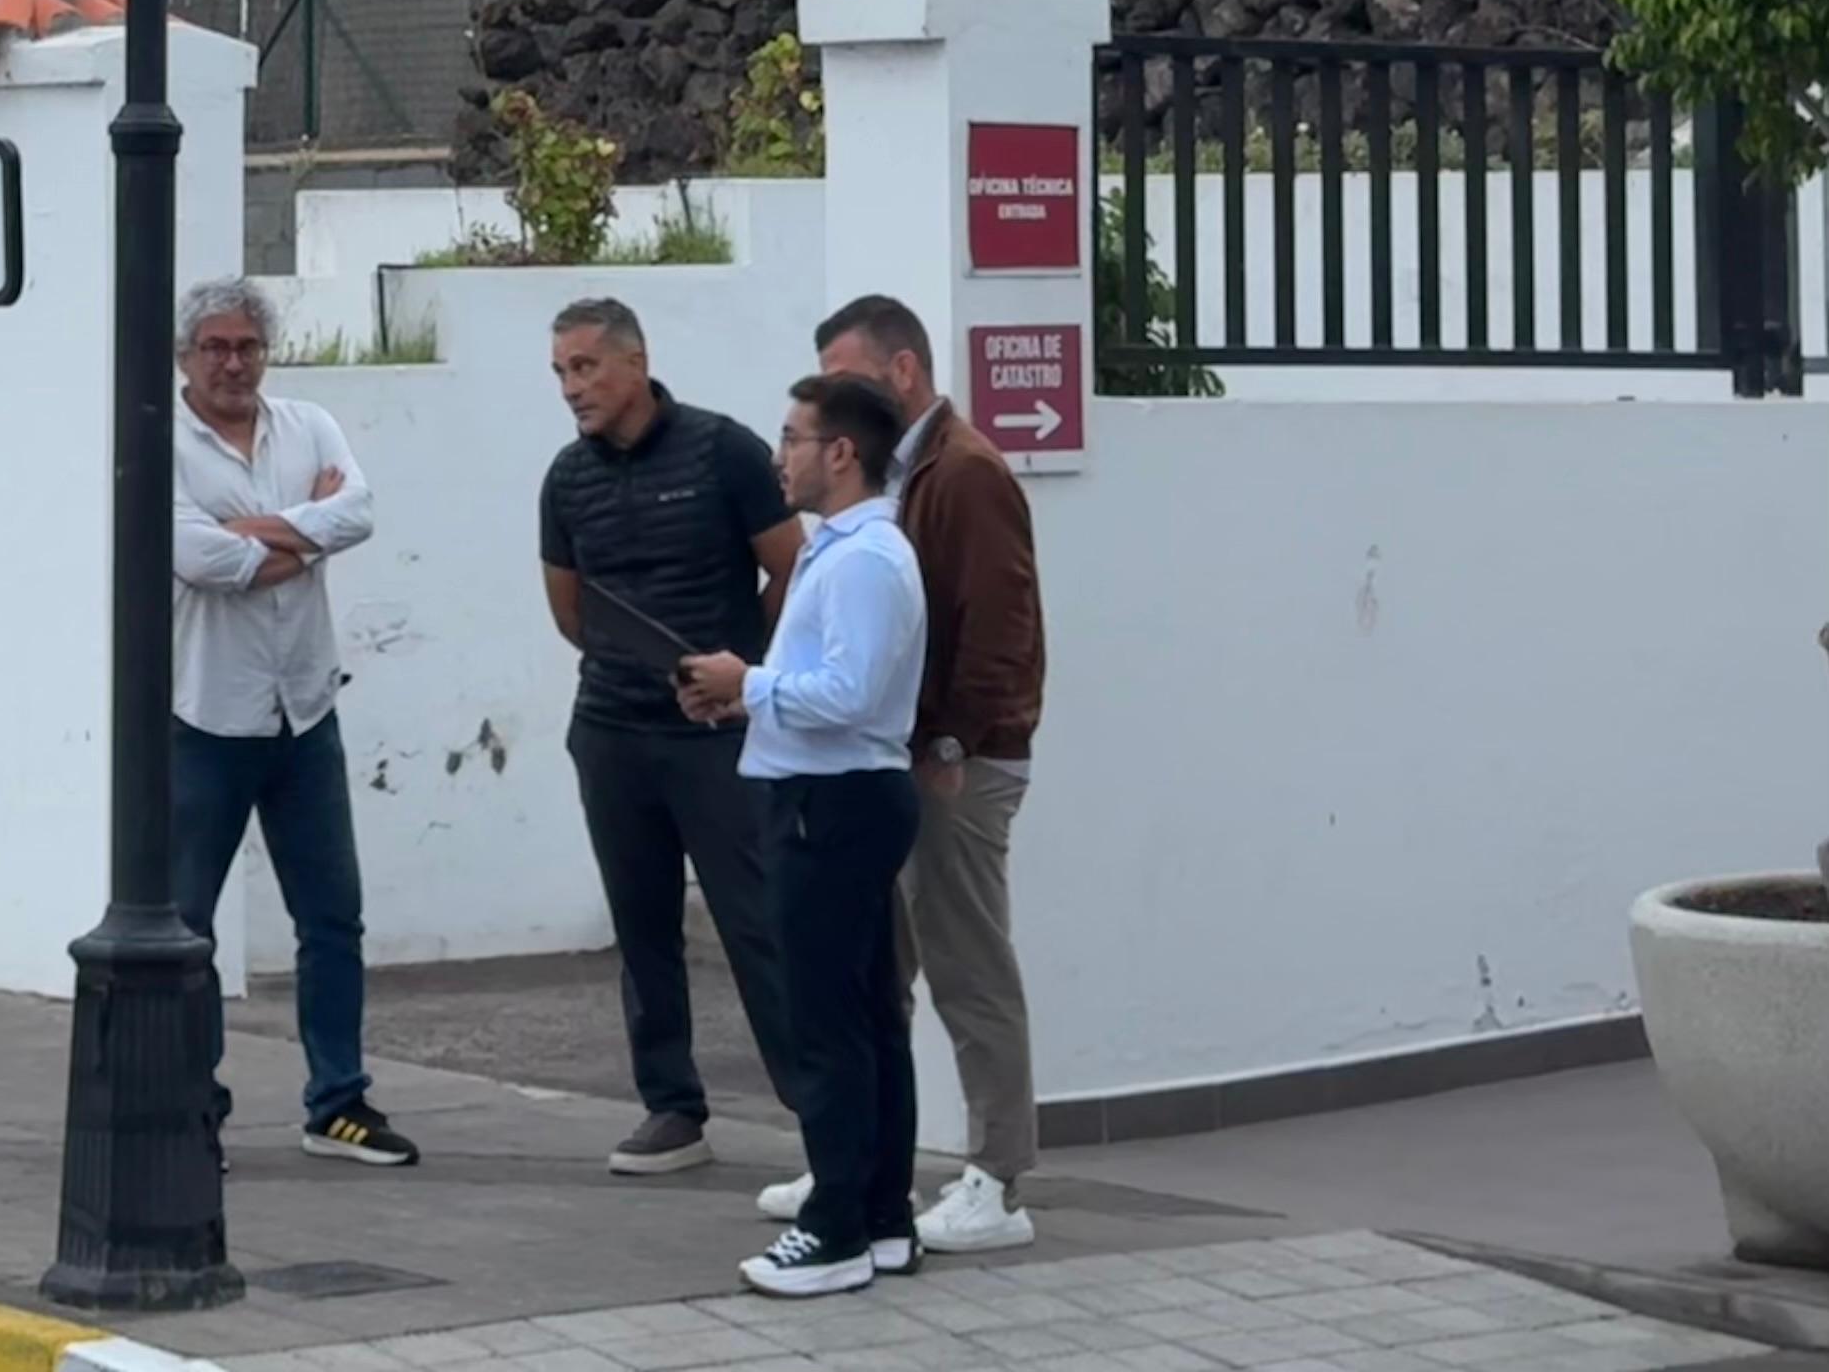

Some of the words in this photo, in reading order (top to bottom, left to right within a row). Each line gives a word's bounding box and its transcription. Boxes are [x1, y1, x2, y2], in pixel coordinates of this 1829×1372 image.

[1021, 173, 1074, 195] TÉCNICA
[997, 203, 1047, 220] ENTRADA
[985, 334, 1041, 360] OFICINA
[1043, 334, 1063, 359] DE
[990, 363, 1063, 390] CATASTRO
